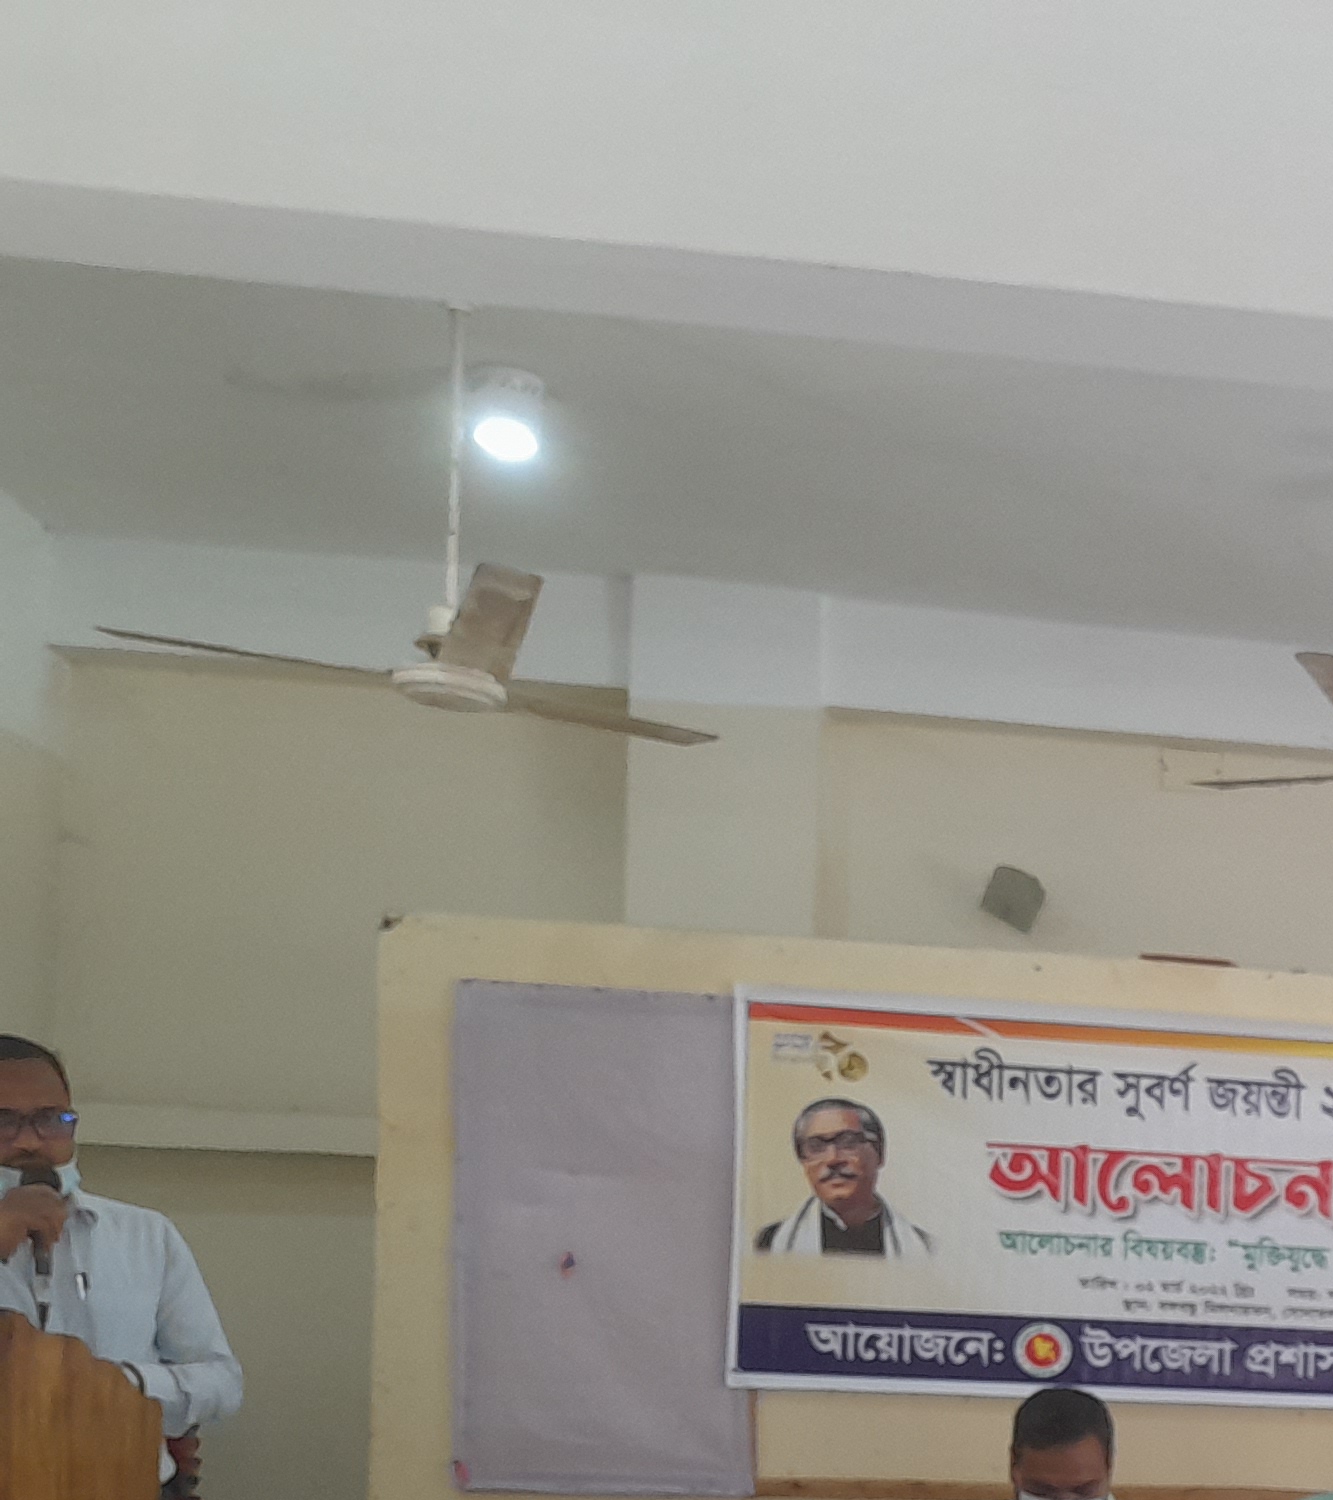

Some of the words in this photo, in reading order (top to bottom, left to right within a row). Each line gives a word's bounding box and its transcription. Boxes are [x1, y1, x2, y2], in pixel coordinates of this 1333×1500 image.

[927, 1047, 1100, 1108] স্বাধীনতার
[1114, 1062, 1197, 1120] সুবর্ণ
[1207, 1066, 1305, 1122] জয়ন্তী
[999, 1230, 1115, 1257] আলোচনার
[1081, 1324, 1238, 1376] উপজেলা
